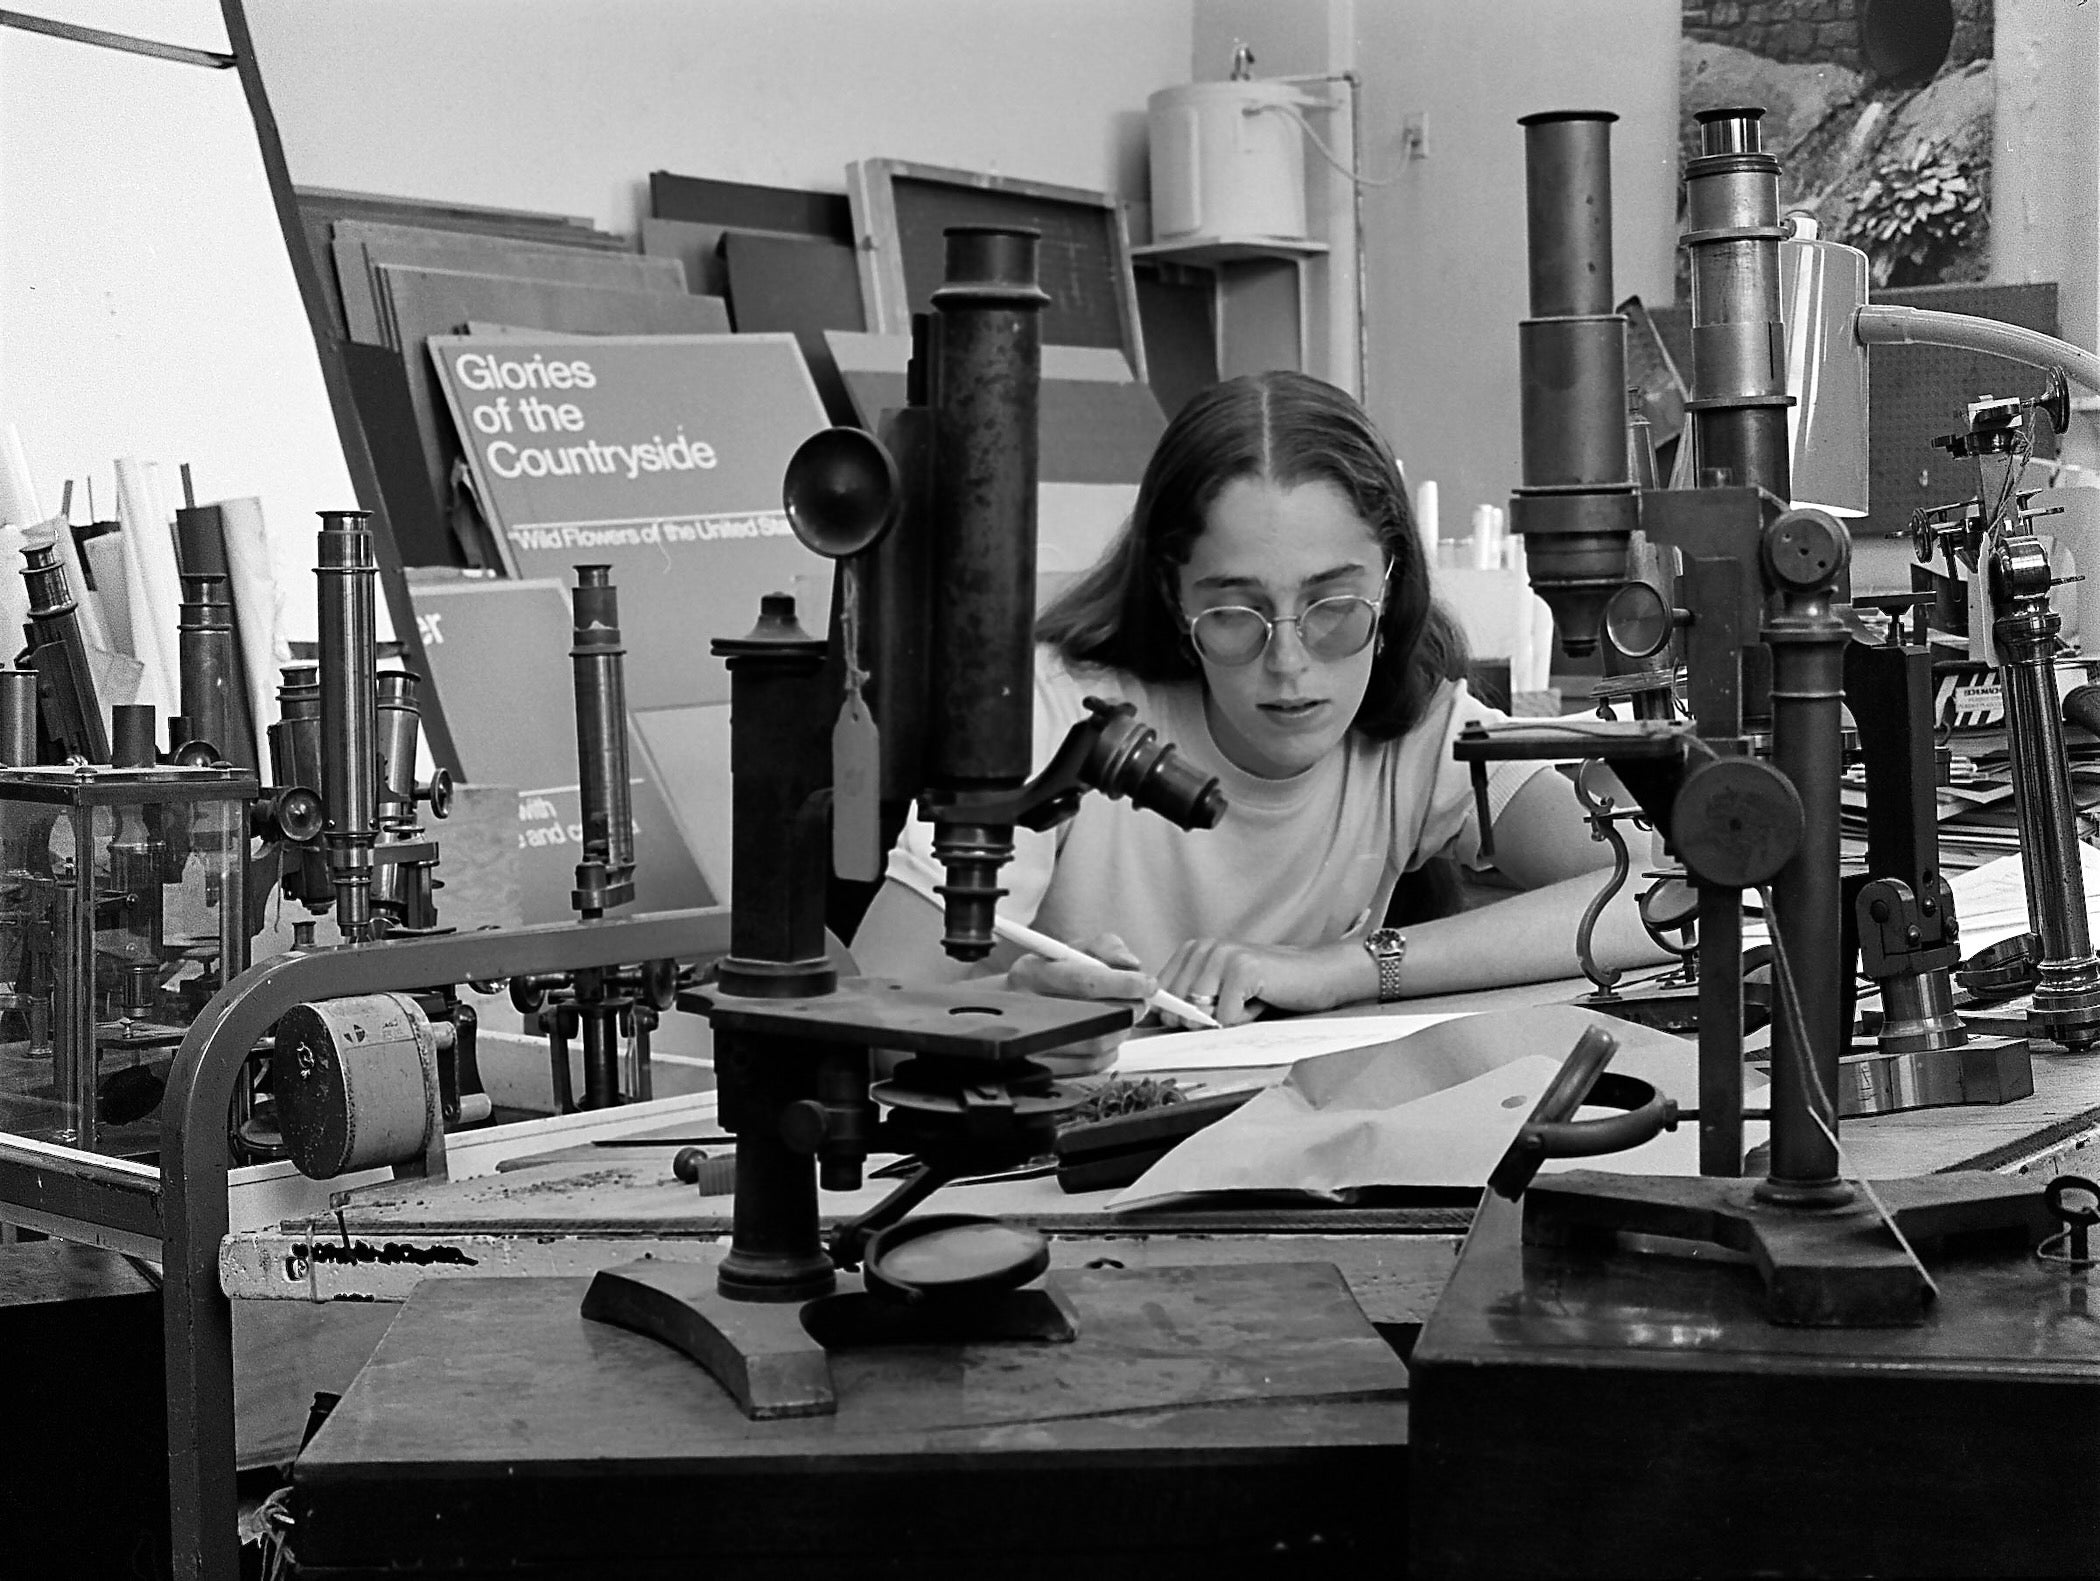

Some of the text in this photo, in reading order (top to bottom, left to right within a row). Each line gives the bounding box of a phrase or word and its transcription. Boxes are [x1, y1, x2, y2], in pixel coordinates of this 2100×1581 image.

[455, 353, 597, 391] Glories
[472, 396, 585, 434] of the
[486, 434, 718, 479] Countryside
[561, 527, 640, 547] Flowers
[640, 521, 660, 544] of
[661, 522, 695, 542] the
[694, 518, 757, 540] United
[525, 821, 567, 846] and
